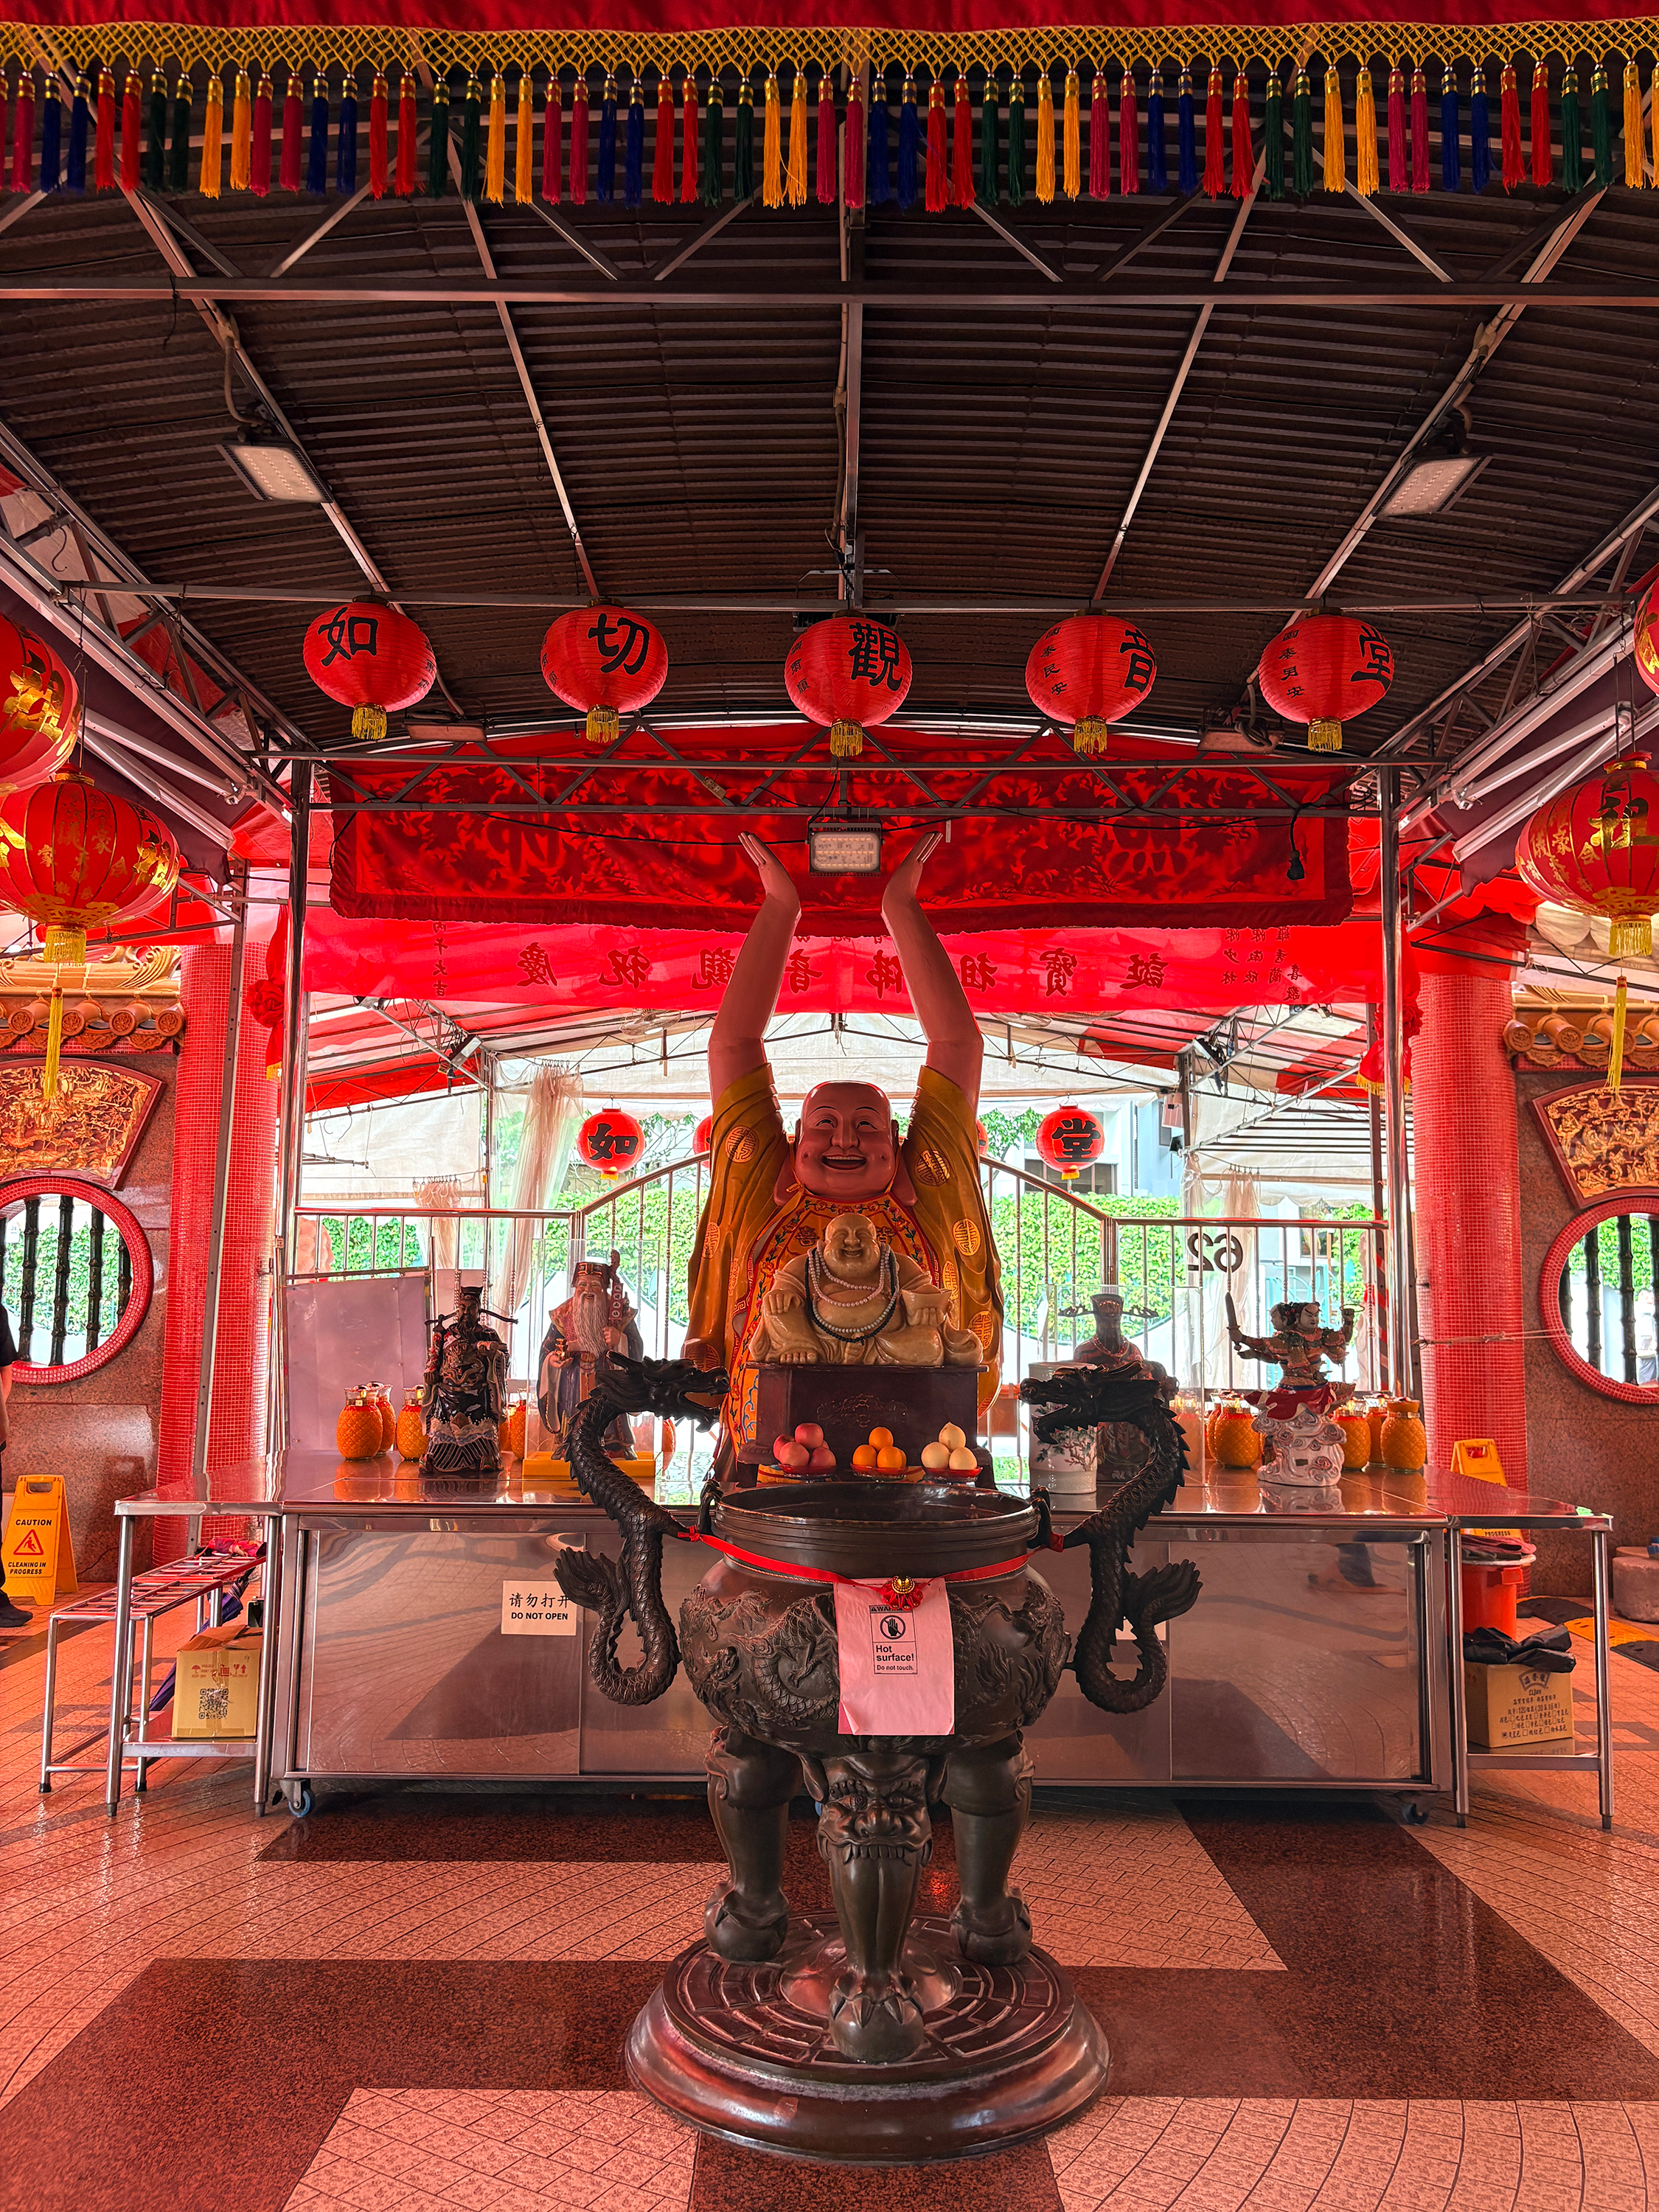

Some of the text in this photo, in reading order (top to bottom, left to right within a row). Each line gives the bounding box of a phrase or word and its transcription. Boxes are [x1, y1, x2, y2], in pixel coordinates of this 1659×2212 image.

[317, 607, 378, 667] 如
[588, 613, 650, 675] 切
[848, 622, 903, 692] 觀
[1350, 625, 1393, 692] 堂
[1119, 628, 1157, 693] 音
[588, 1123, 639, 1161] 如
[1051, 1119, 1102, 1163] 堂
[509, 1592, 571, 1609] 请勿打开
[511, 1612, 568, 1621] DO NOT OPEN
[875, 1644, 892, 1653] Hot
[876, 1653, 914, 1662] surface!
